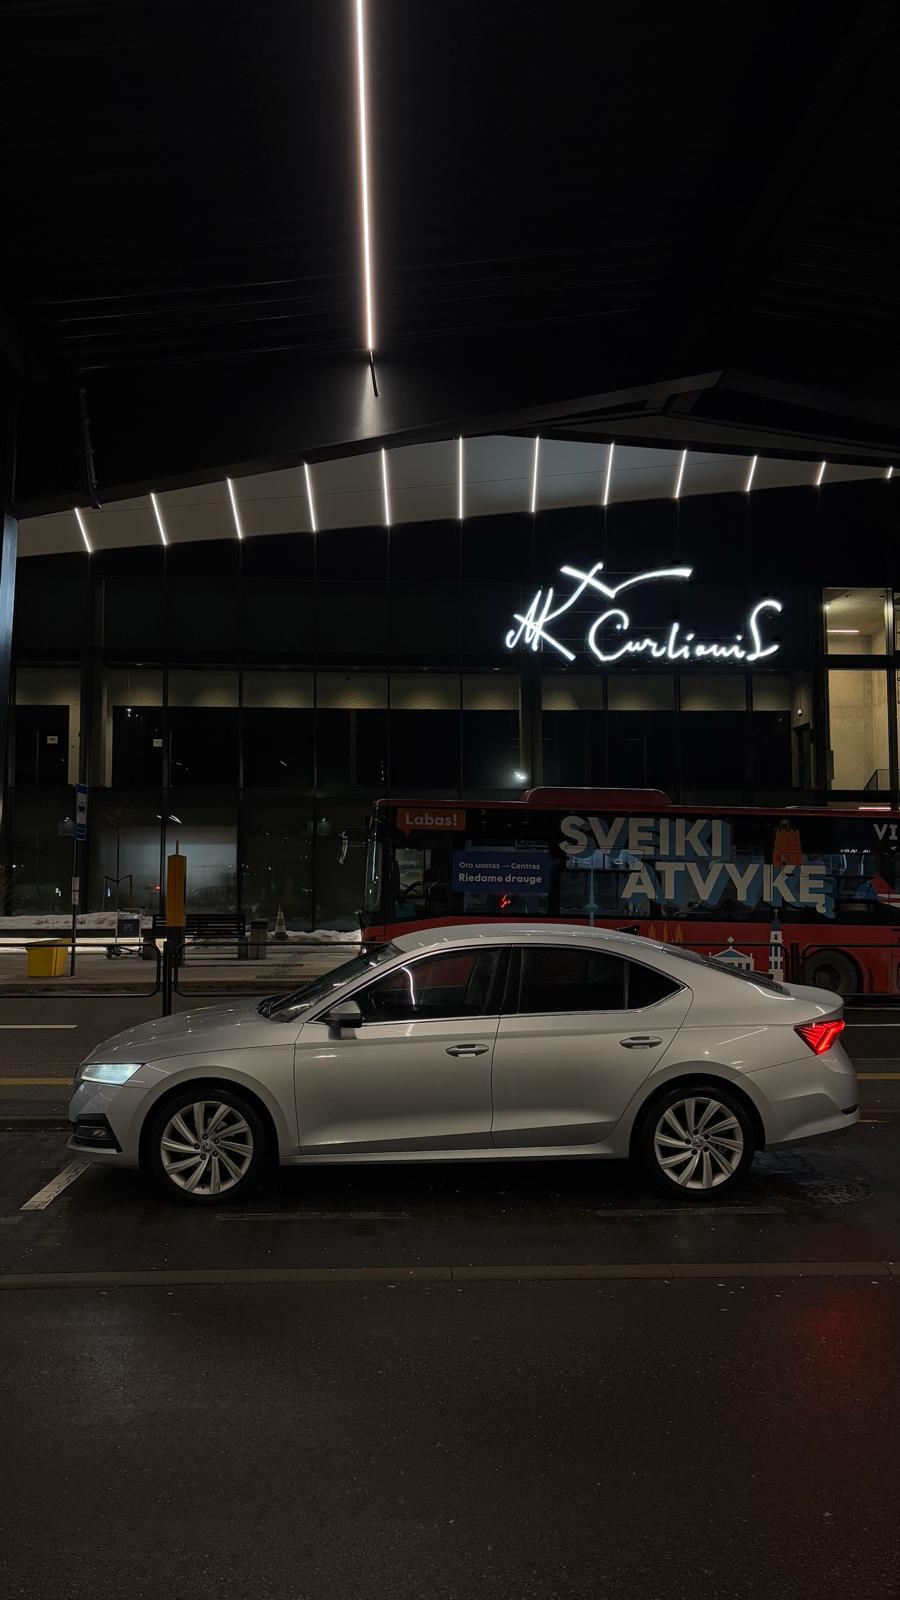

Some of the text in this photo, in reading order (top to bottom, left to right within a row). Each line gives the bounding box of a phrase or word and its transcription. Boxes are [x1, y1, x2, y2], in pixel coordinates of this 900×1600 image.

[405, 812, 458, 826] Labas!
[558, 815, 723, 857] SVEIKI
[459, 862, 473, 870] Oro
[475, 862, 500, 870] uostas
[511, 862, 540, 870] Centras
[458, 873, 542, 885] Riedame drauge
[621, 861, 827, 913] ATVYKĘ
